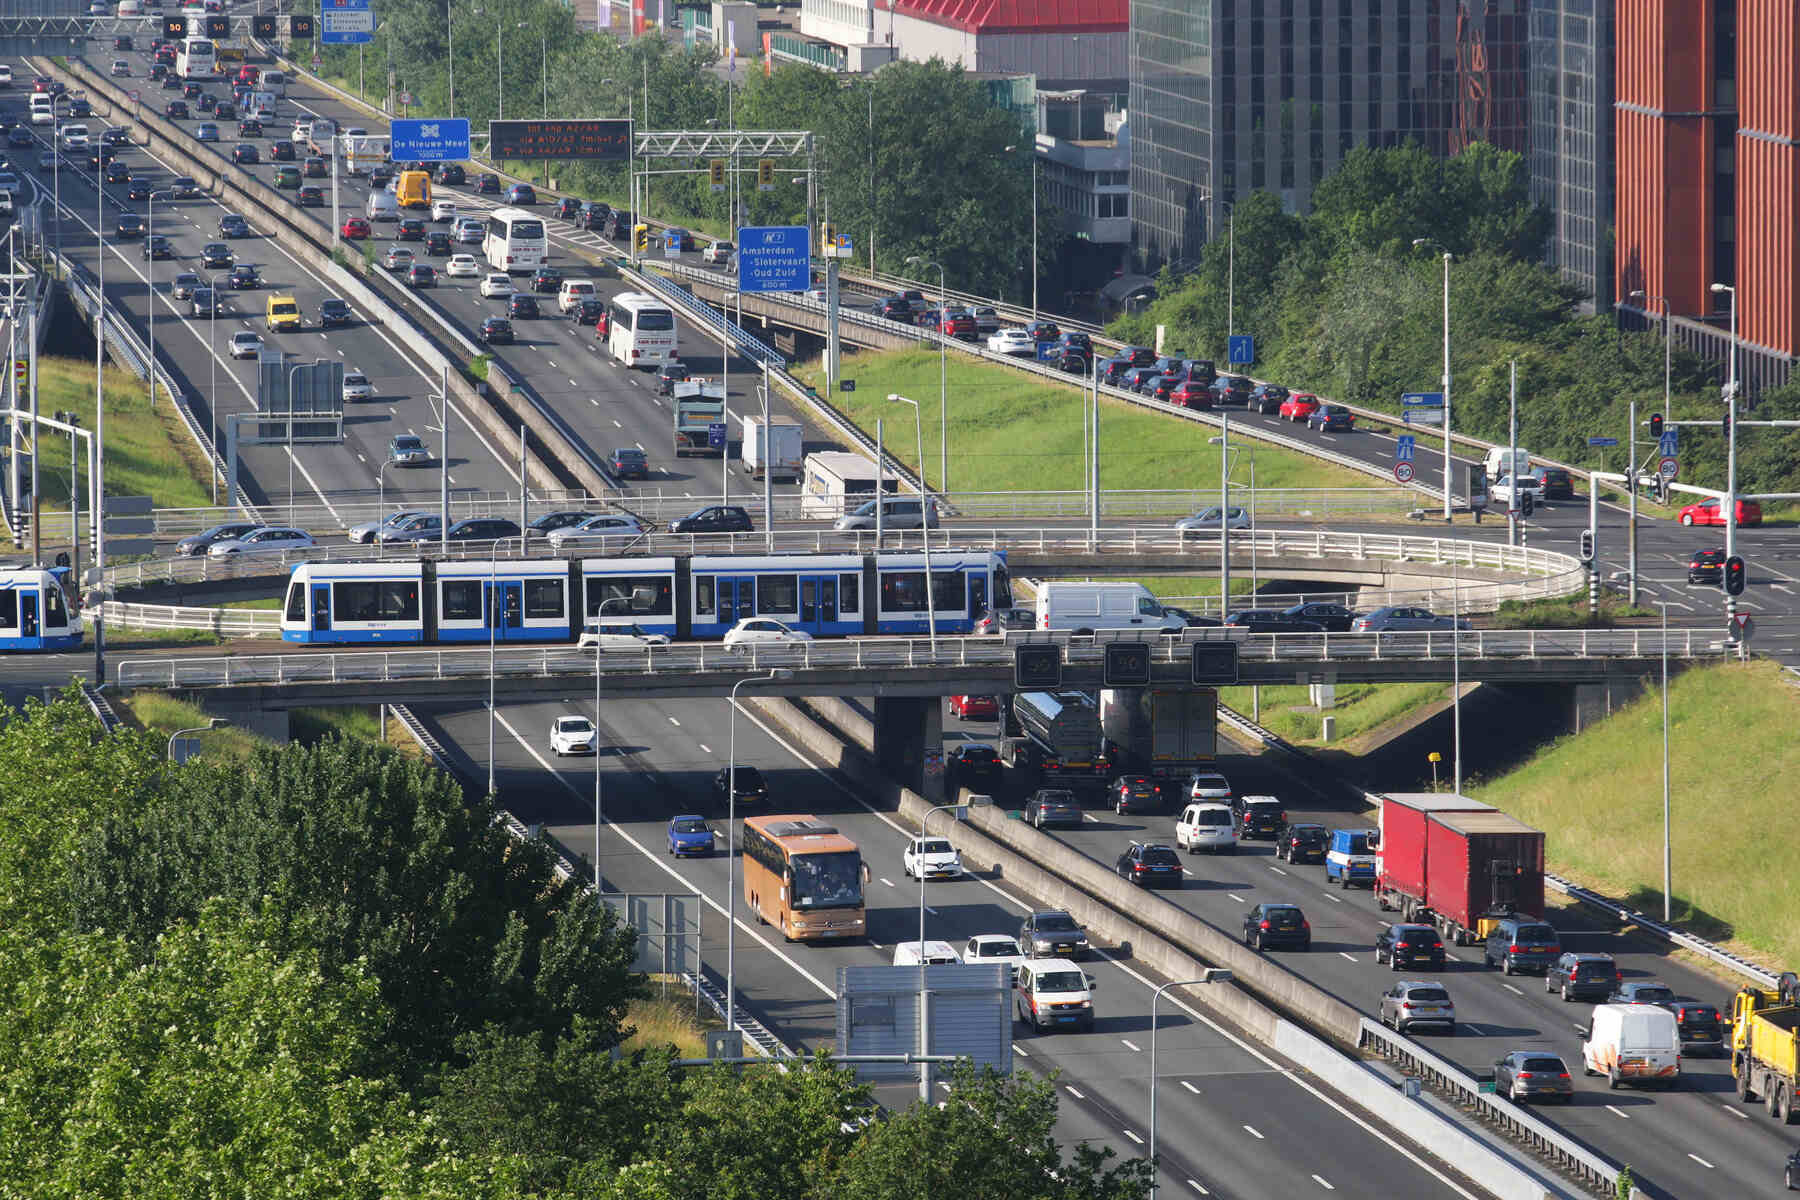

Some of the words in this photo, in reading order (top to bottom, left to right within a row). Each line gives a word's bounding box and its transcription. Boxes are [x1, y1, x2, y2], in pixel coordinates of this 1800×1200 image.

[393, 139, 406, 149] De
[408, 139, 442, 148] Nieuwe
[445, 139, 467, 148] Meer
[742, 247, 795, 255] Amsterdam
[775, 268, 797, 277] Zuid
